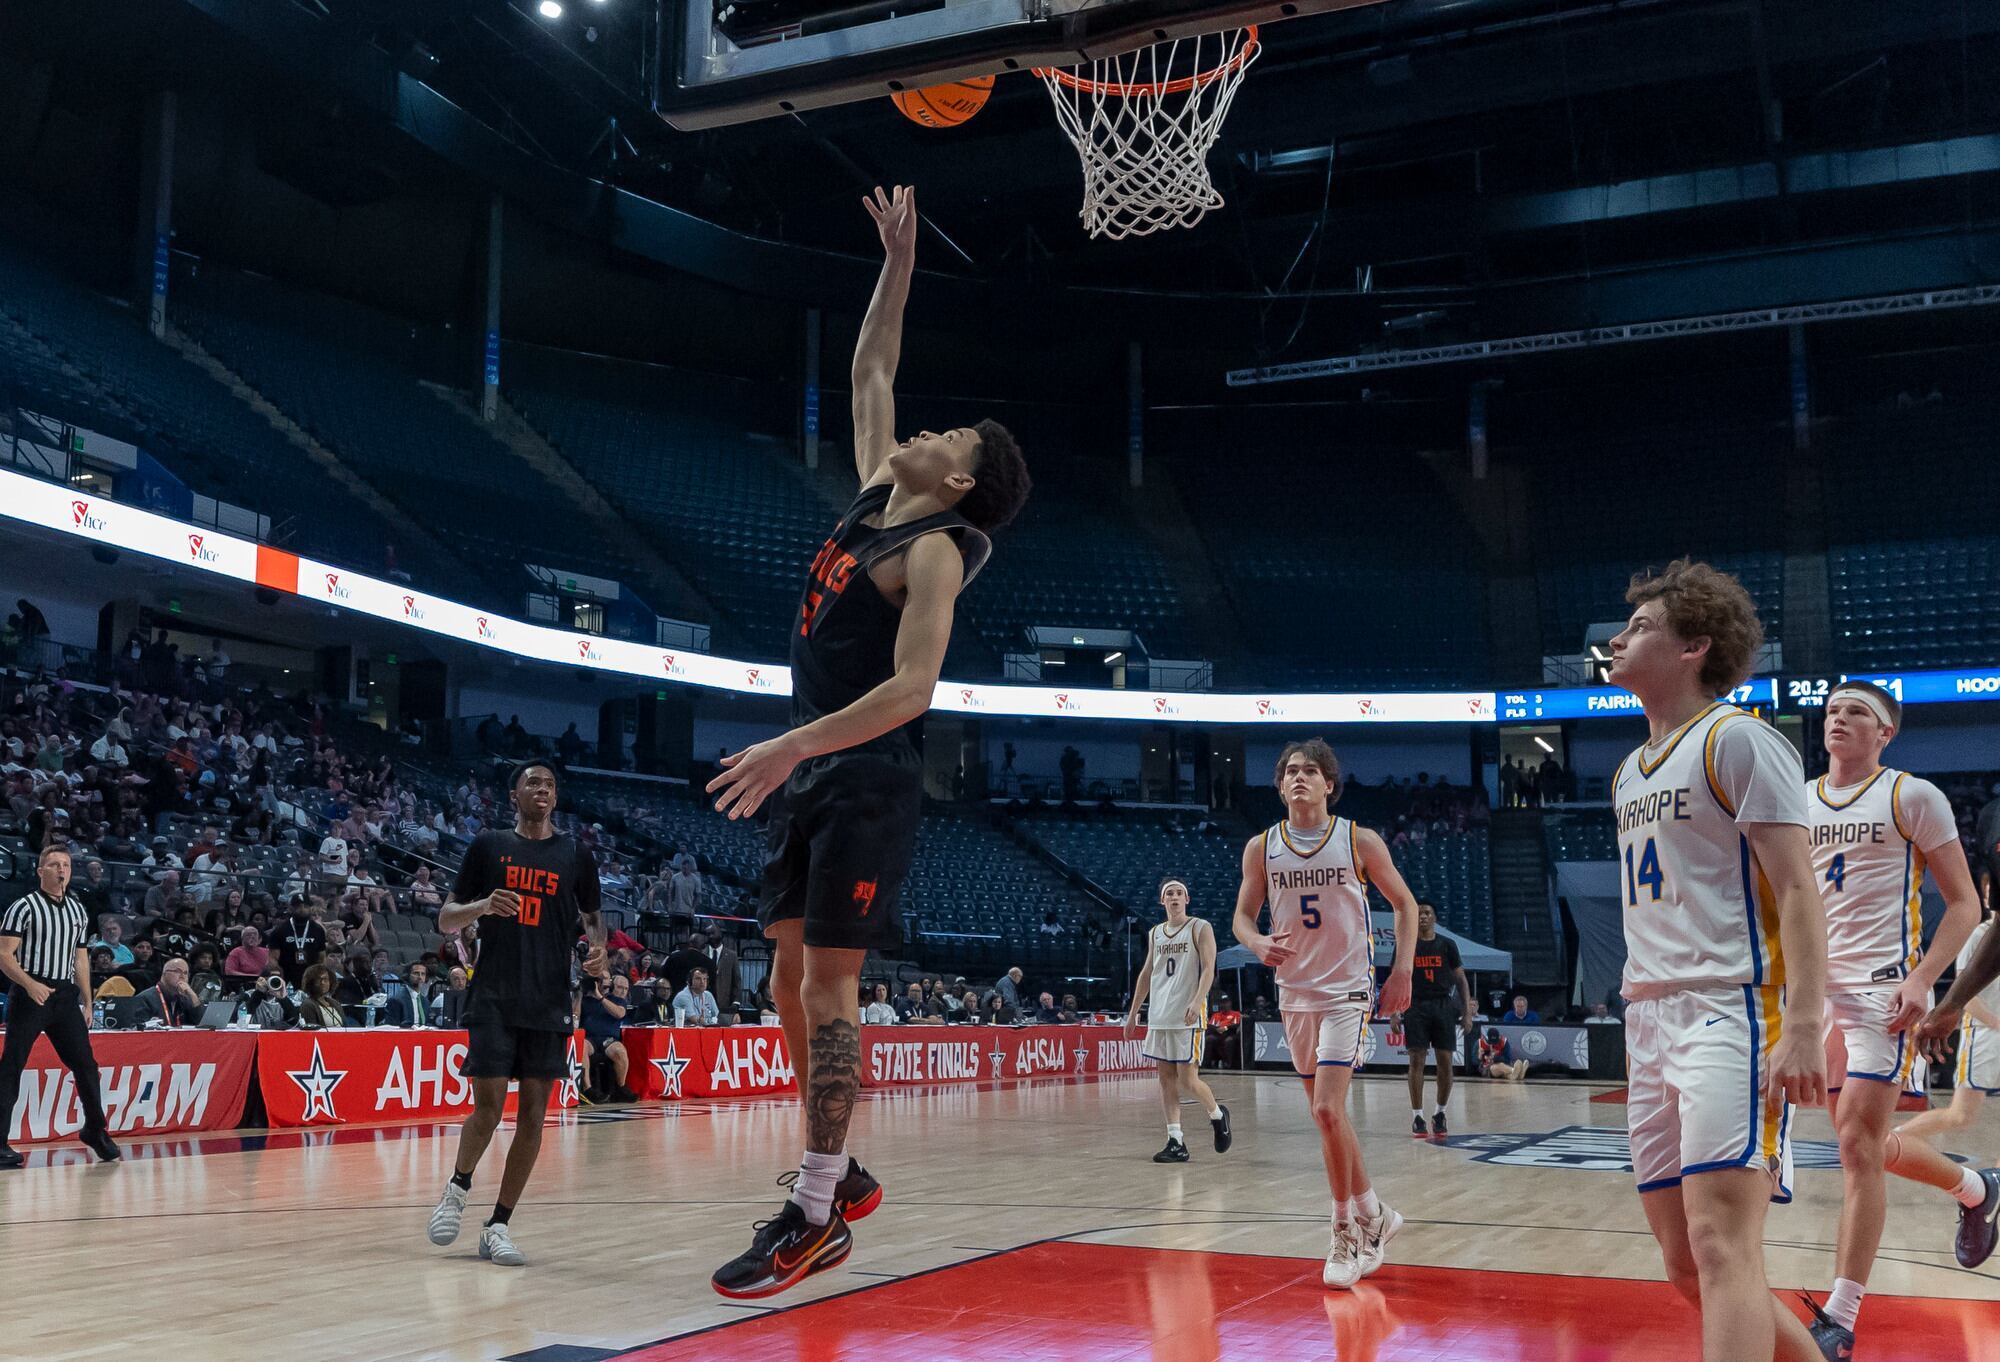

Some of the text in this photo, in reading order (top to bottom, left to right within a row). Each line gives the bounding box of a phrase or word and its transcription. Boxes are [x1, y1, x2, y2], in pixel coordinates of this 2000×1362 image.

[1504, 694, 1543, 705] TOL 3
[1788, 679, 1829, 697] 20.2
[1956, 677, 2000, 694] HOO
[1505, 708, 1527, 718] FLS
[1616, 787, 1692, 835] AIRHOPE
[1808, 822, 1886, 846] IRHOPE
[505, 865, 560, 896] BUCS
[1271, 867, 1348, 889] FAIRHOPE
[1625, 835, 1665, 907] 14
[1825, 852, 1846, 893] 4
[517, 894, 542, 927] 10
[1299, 893, 1322, 930] 5
[1166, 957, 1176, 978] 0
[1415, 955, 1442, 968] BUCS
[1424, 969, 1434, 984] 4
[871, 1041, 979, 1081] STATE FINALS
[1015, 1037, 1065, 1075] AHSAA
[1098, 1039, 1157, 1072] BIRMIN
[375, 1043, 475, 1111] AHS
[7, 1063, 217, 1140] NGHAM
